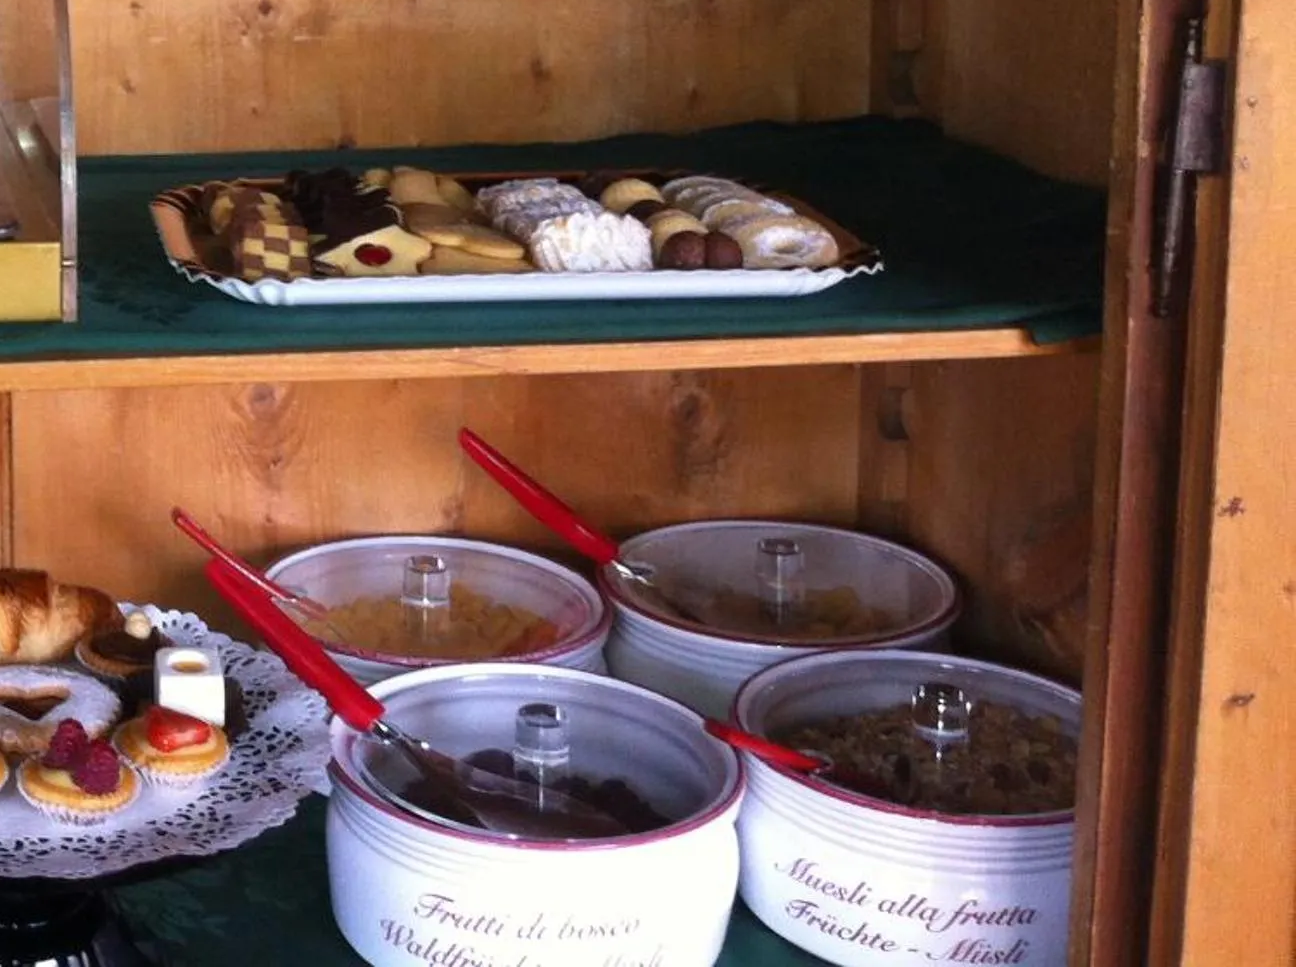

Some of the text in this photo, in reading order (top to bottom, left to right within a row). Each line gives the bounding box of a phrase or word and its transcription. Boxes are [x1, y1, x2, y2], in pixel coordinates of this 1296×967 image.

[413, 893, 510, 936] Frutti
[516, 913, 547, 940] di
[774, 857, 1036, 933] Muesli alla frutta
[785, 899, 897, 953] Früchte
[926, 937, 1030, 966] Müsli
